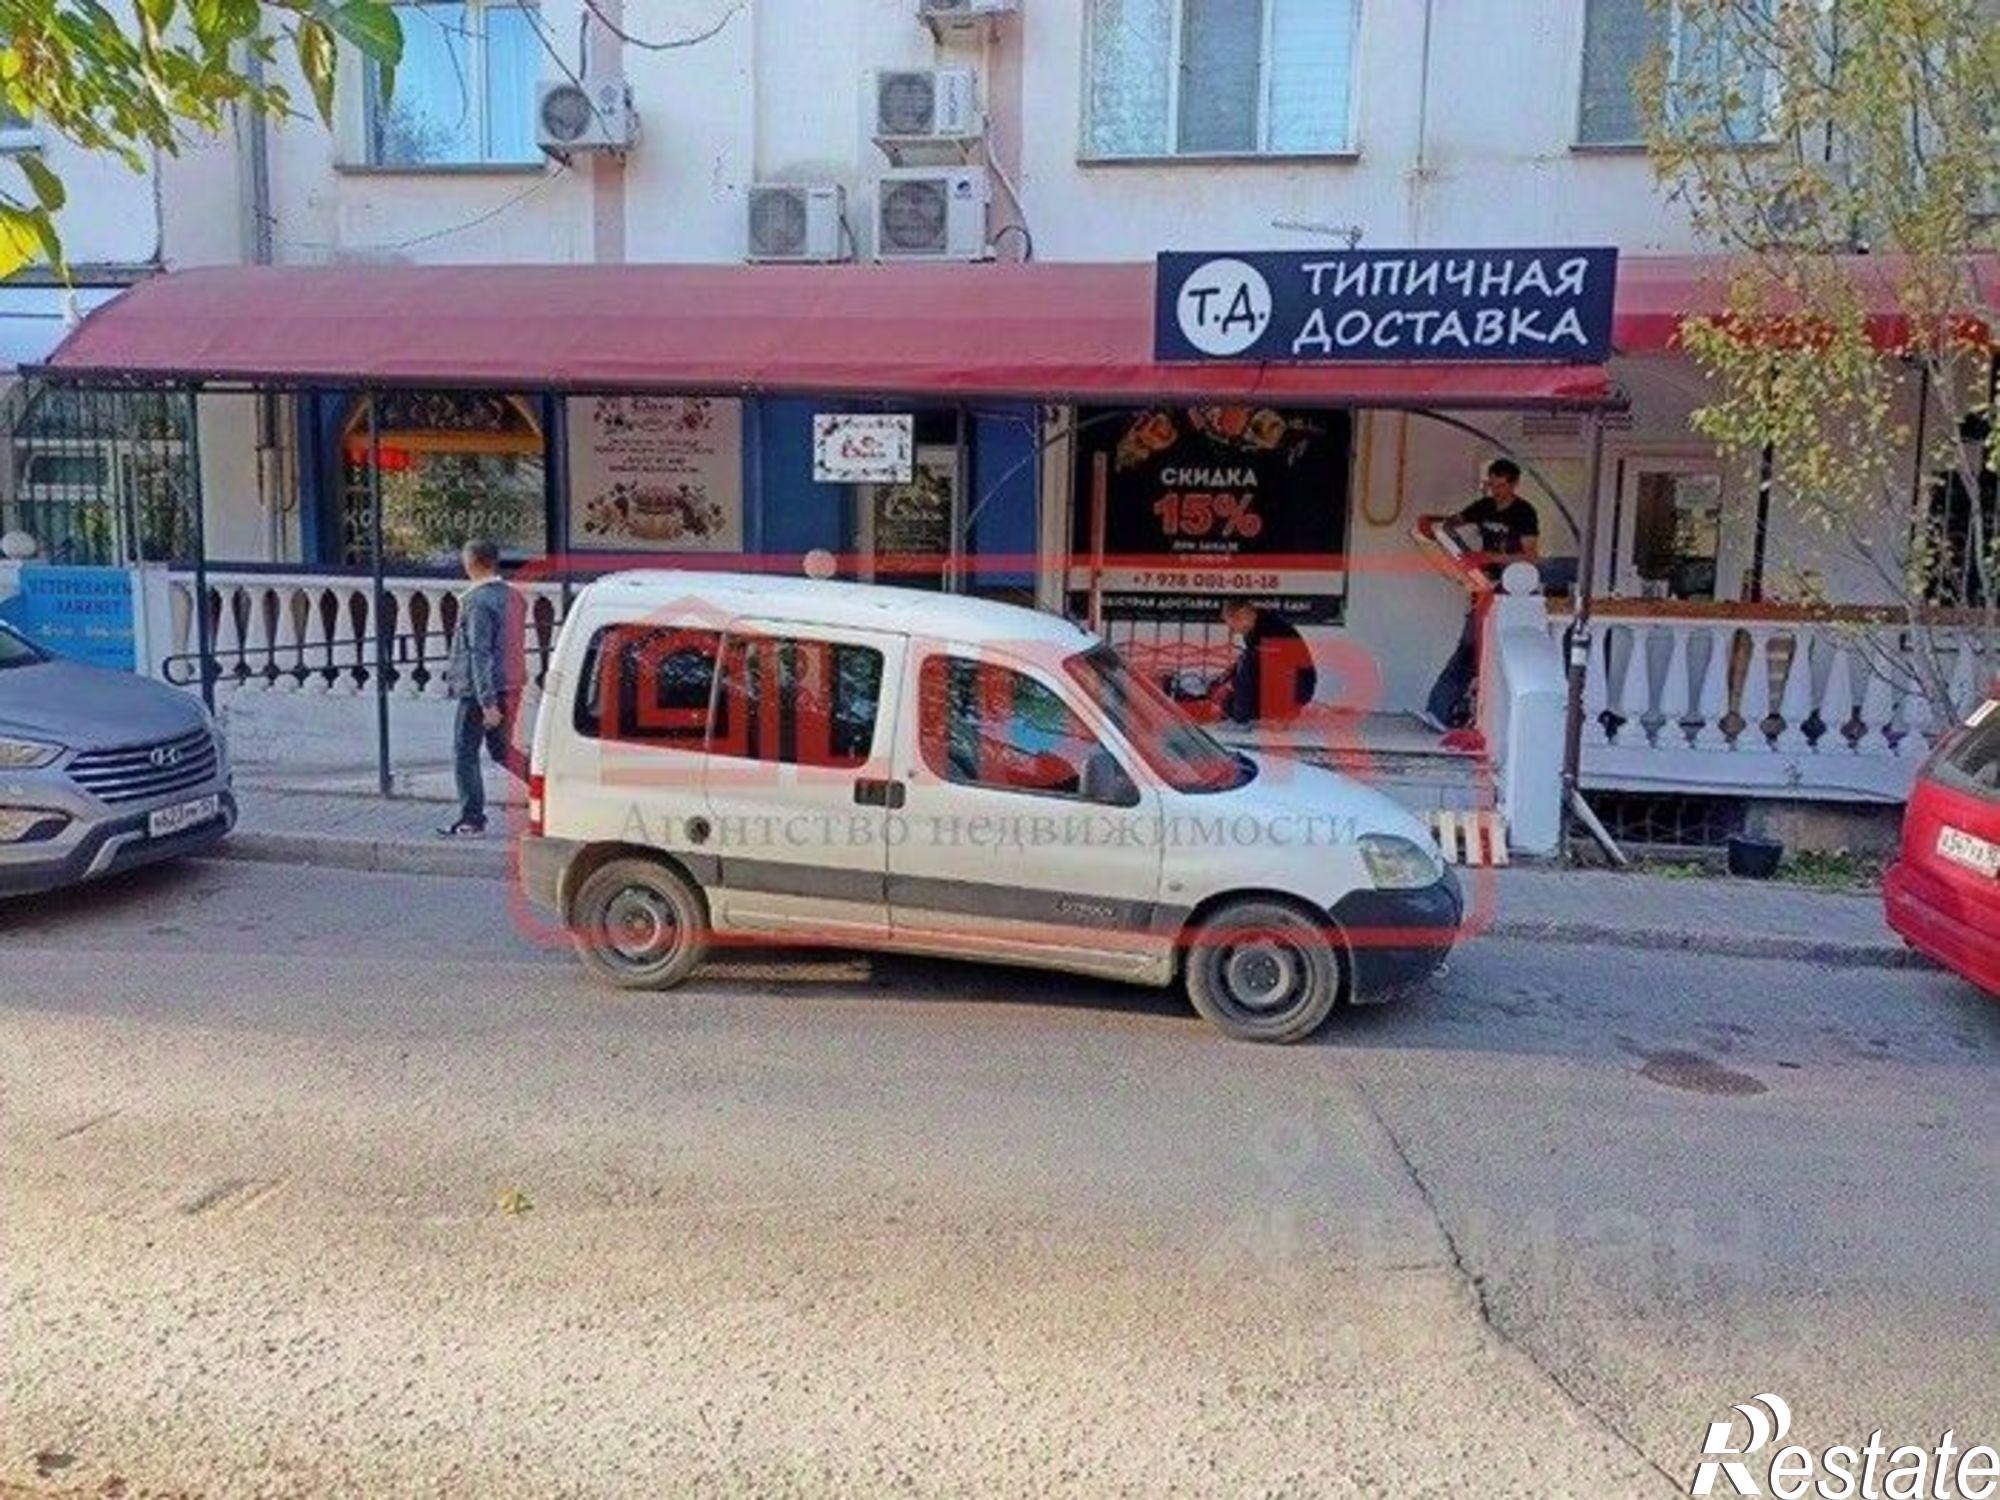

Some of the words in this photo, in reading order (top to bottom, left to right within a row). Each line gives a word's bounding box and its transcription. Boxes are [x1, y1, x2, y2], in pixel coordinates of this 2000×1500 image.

[1302, 257, 1589, 297] ТИПИЧНАЯ
[1188, 283, 1266, 334] Т.Д.
[1292, 307, 1589, 354] ДОСТАВКА
[1161, 467, 1258, 487] СКИДКА
[1153, 492, 1263, 538] 15%
